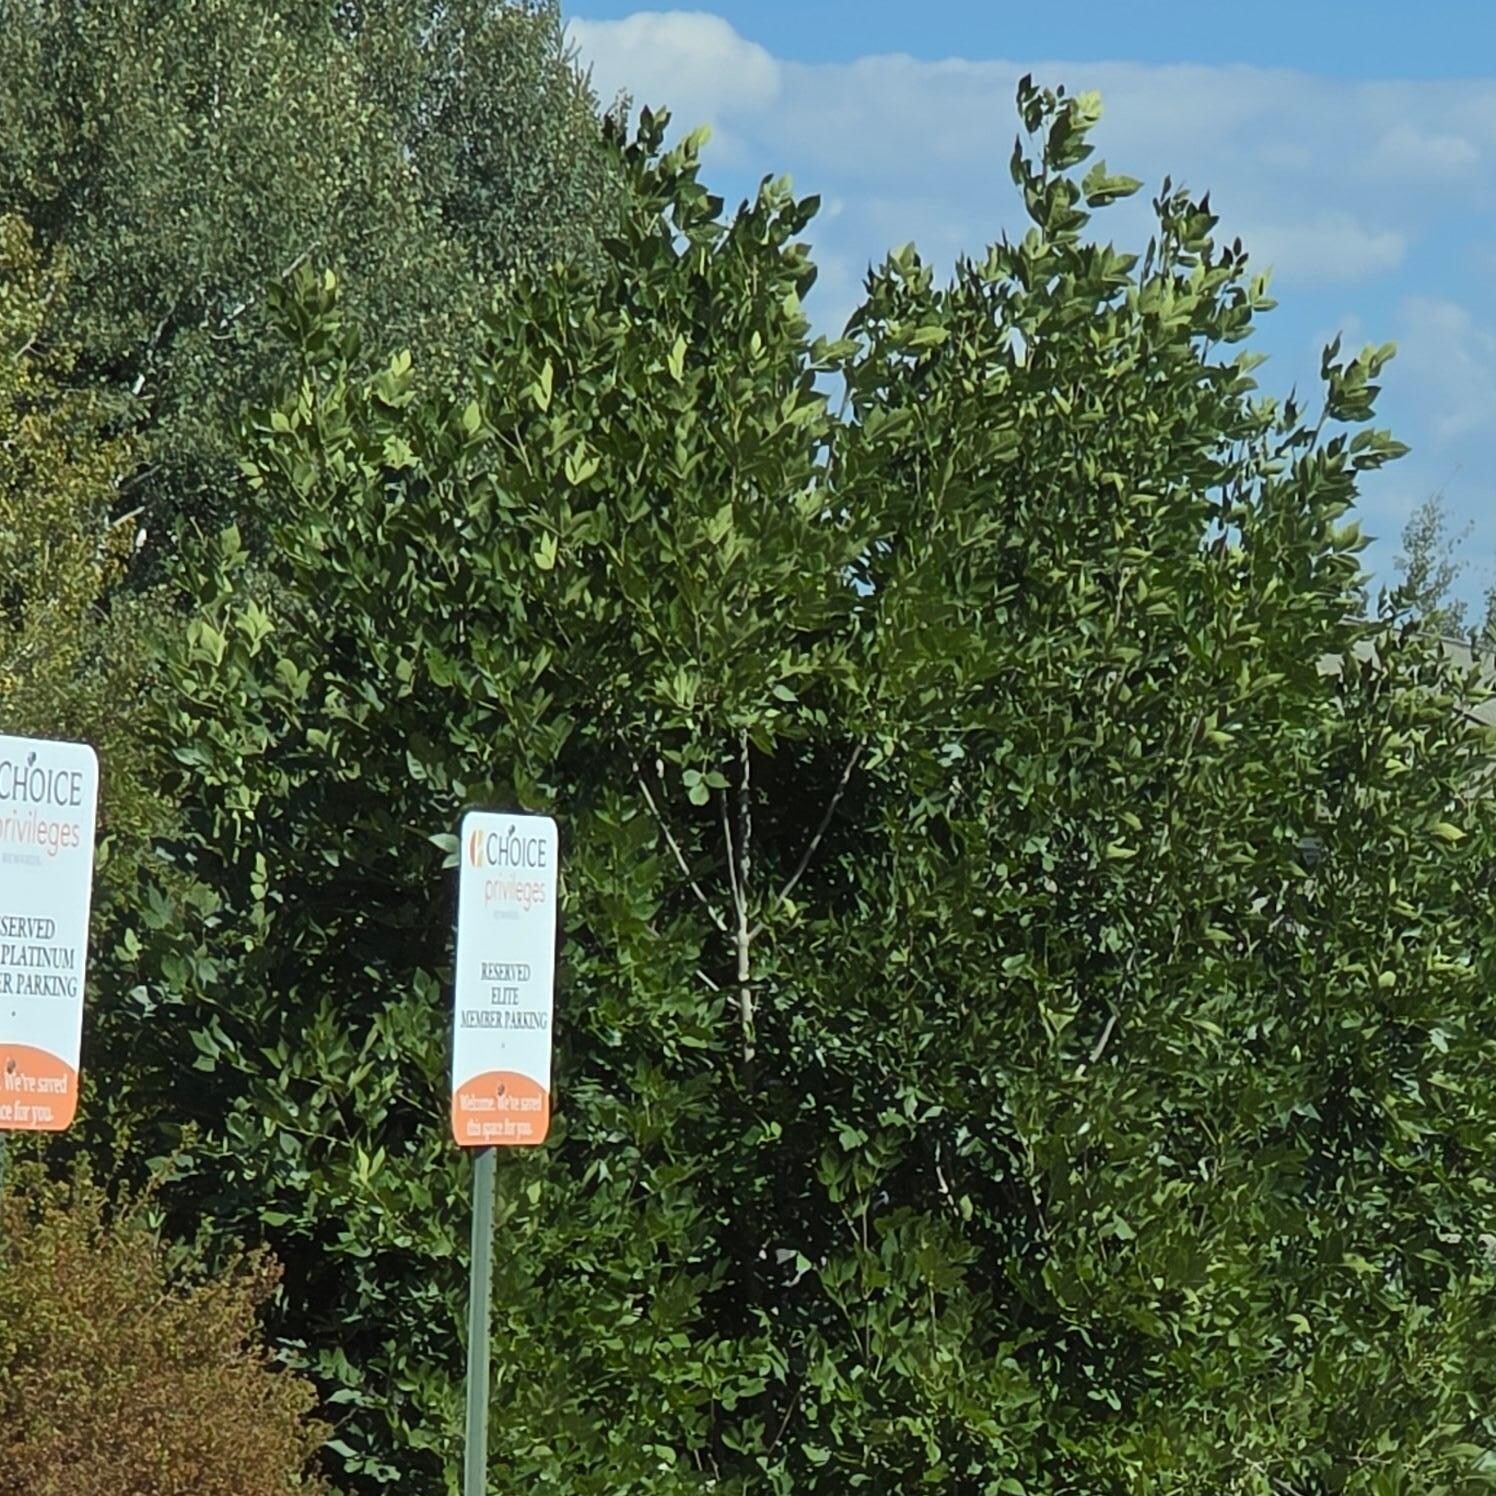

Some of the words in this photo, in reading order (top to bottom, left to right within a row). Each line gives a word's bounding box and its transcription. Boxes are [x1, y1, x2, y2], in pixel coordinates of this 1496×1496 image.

[0, 760, 82, 807] CHOICE
[0, 809, 80, 857] rivileges
[486, 831, 547, 868] CHOICE
[484, 872, 546, 912] privileges
[0, 915, 56, 939] SERVED
[1, 944, 75, 970] PLATINUM
[481, 962, 532, 981] RESERVED
[16, 973, 78, 998] PARKING
[491, 987, 519, 1005] ELITE
[460, 1010, 502, 1029] MEMBER
[505, 1010, 548, 1030] PARKING
